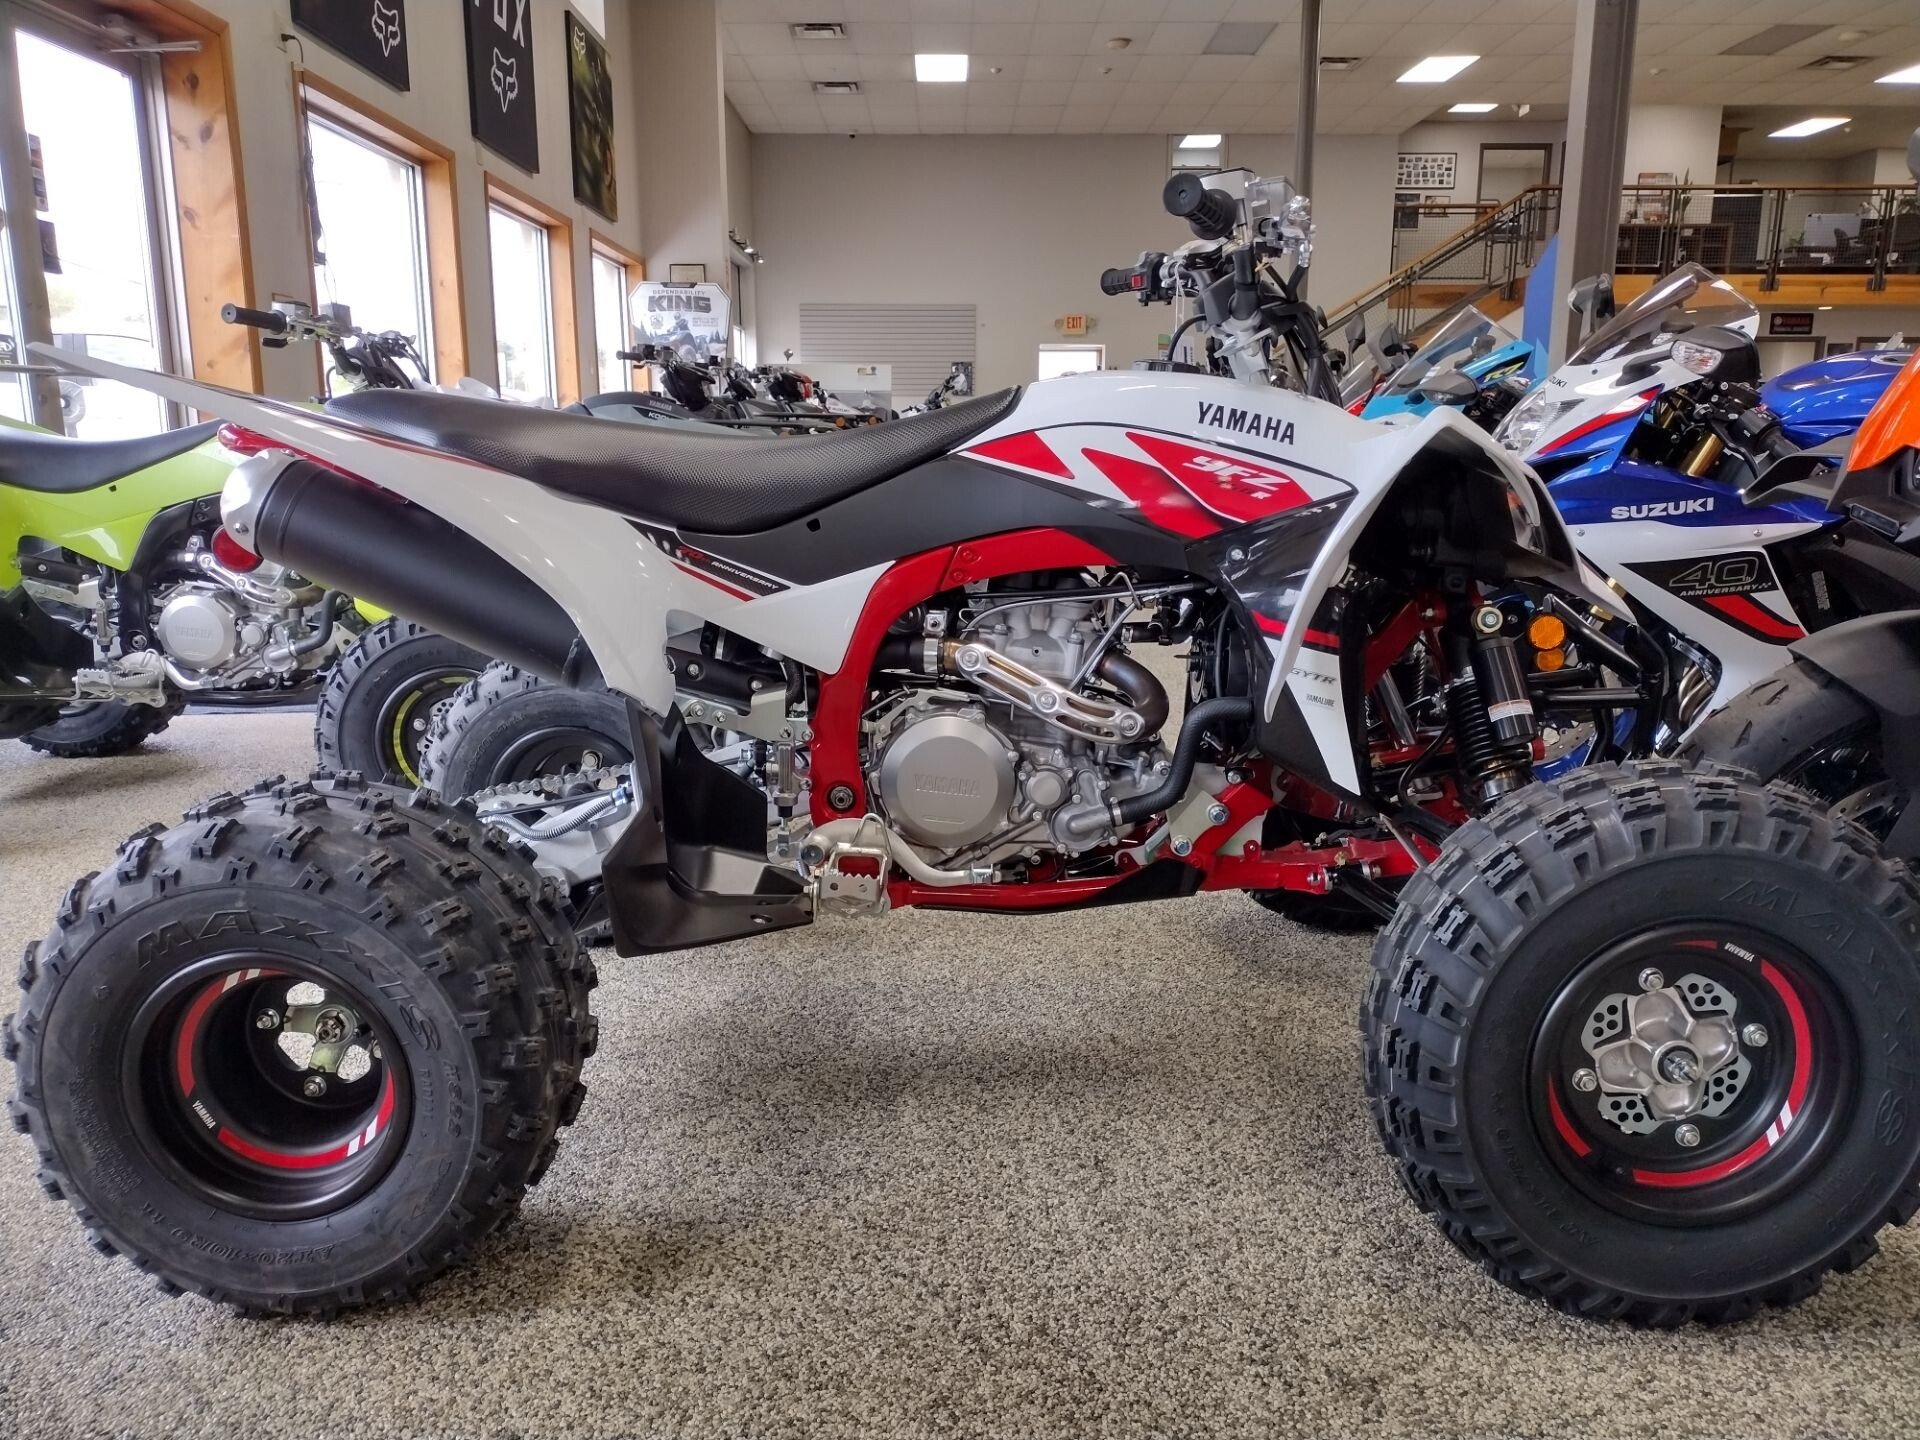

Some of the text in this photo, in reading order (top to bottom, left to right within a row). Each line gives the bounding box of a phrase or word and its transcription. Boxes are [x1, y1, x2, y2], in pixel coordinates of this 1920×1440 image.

[648, 295, 711, 313] KING
[1067, 317, 1082, 329] EXIT
[1198, 401, 1296, 445] YAMAHA
[1611, 497, 1714, 519] SUZUKI
[711, 561, 779, 590] ANNIVERSARY
[1679, 583, 1760, 597] ANNIVERSARY
[1292, 667, 1336, 685] GYTR
[914, 773, 981, 798] YAMAHA
[1724, 940, 1757, 962] YAMAHA
[136, 907, 443, 1053] MAXXIS
[191, 1098, 217, 1130] YAMAHA
